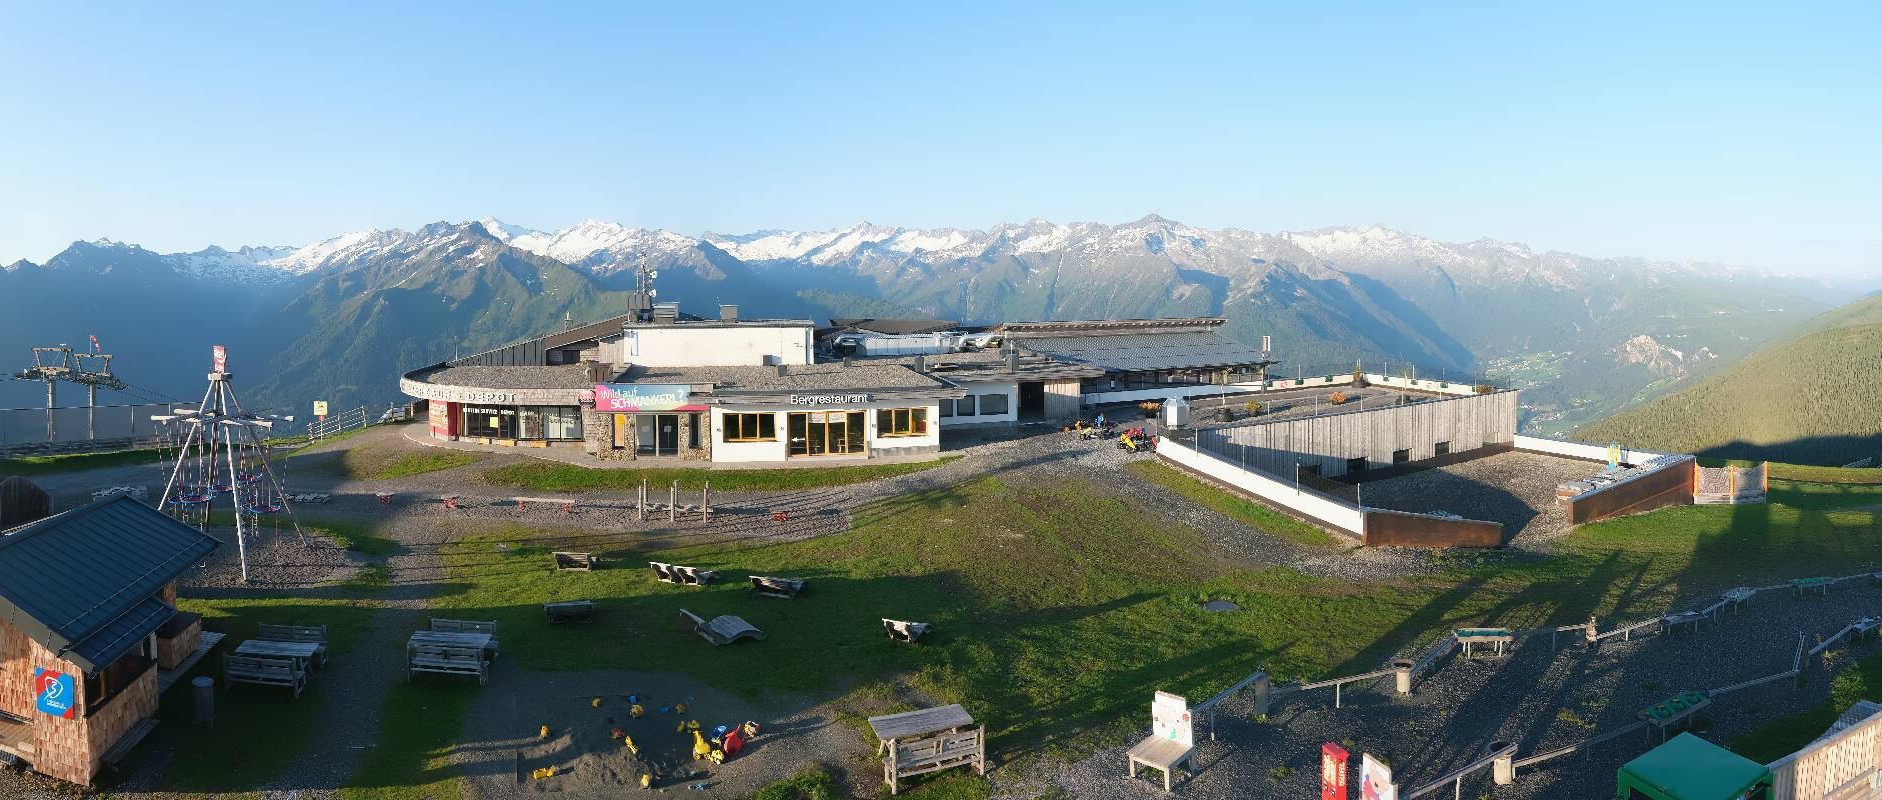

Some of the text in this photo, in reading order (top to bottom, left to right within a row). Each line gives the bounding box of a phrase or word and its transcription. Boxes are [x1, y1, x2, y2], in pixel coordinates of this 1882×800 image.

[468, 392, 516, 403] DEPOT
[600, 388, 621, 399] Wild
[622, 387, 638, 397] auf
[790, 394, 869, 406] Bergrestaurant
